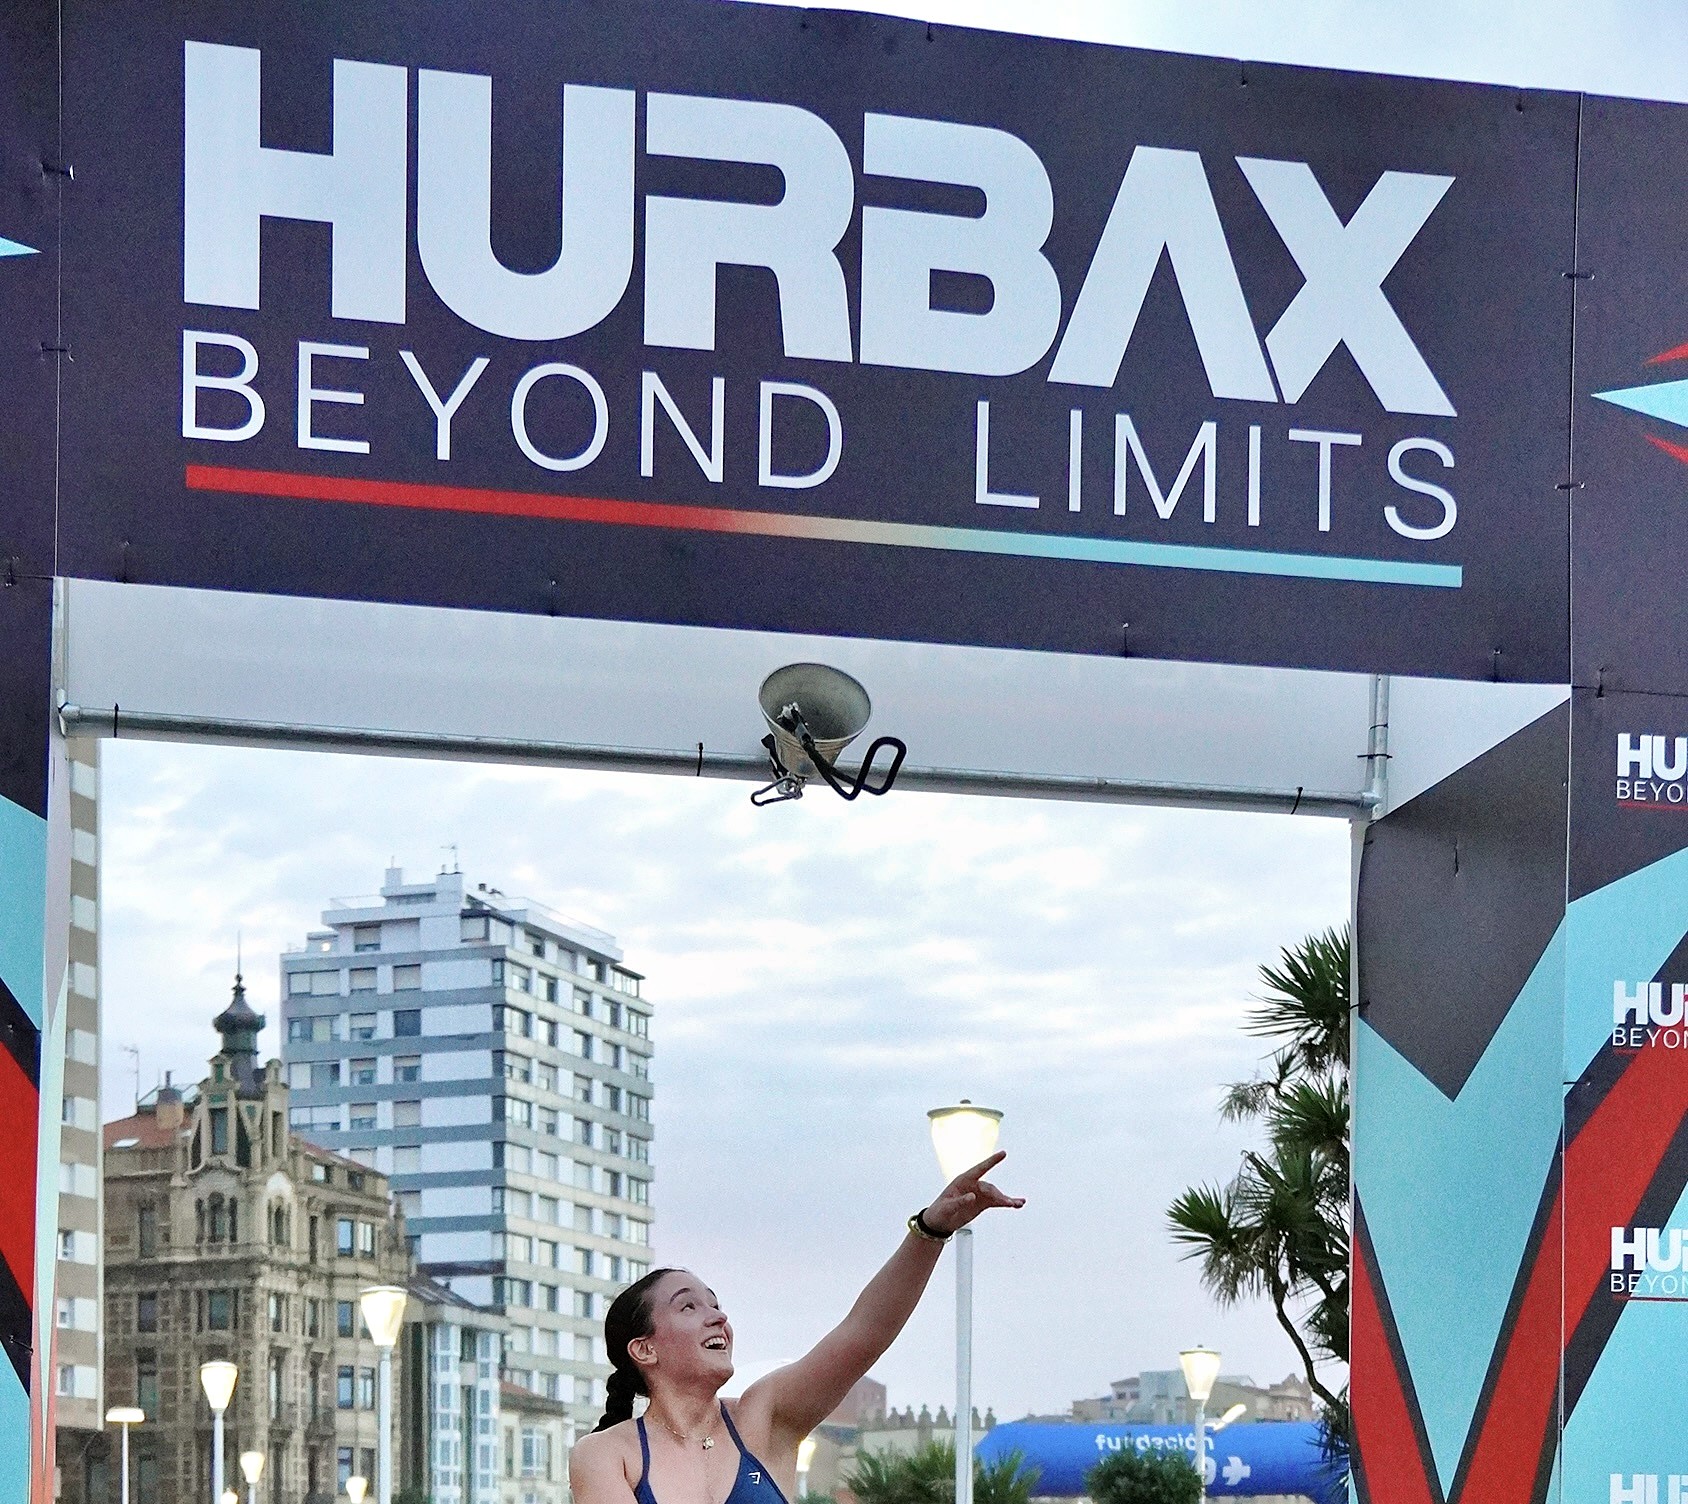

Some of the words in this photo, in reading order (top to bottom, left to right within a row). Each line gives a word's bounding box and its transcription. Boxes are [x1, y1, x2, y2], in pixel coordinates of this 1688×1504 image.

[184, 40, 1457, 418] HURBAX
[183, 330, 842, 489] BEYOND
[976, 401, 1457, 540] LIMITS
[1616, 780, 1688, 802] BEYO
[1614, 980, 1688, 1026] HU
[1611, 1227, 1688, 1272] HU
